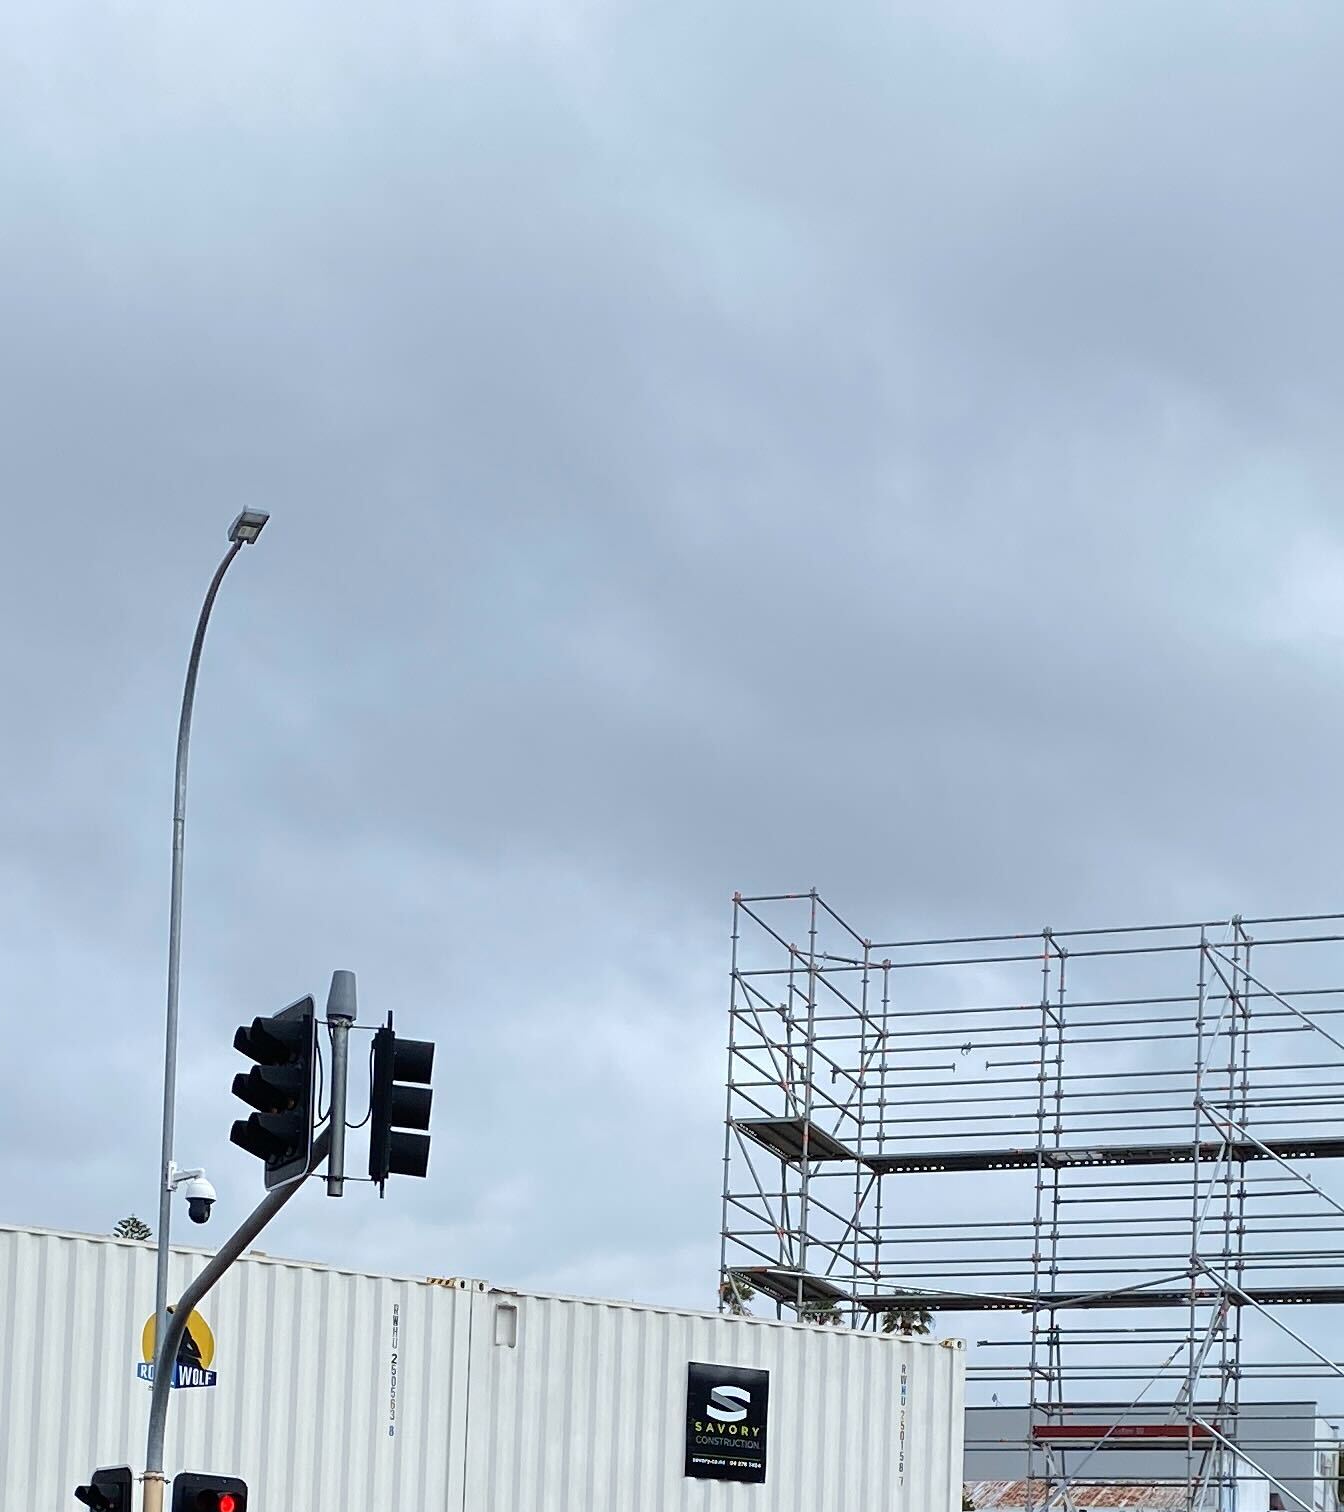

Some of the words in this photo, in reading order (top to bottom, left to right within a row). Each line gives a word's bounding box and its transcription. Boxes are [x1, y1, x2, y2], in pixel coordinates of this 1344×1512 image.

[178, 1365, 213, 1386] WOLF
[389, 1353, 398, 1421] 250563
[388, 1425, 395, 1437] 8
[694, 1421, 760, 1437] SAVORY
[695, 1435, 761, 1450] CONSTRUCTION
[898, 1476, 904, 1487] 7
